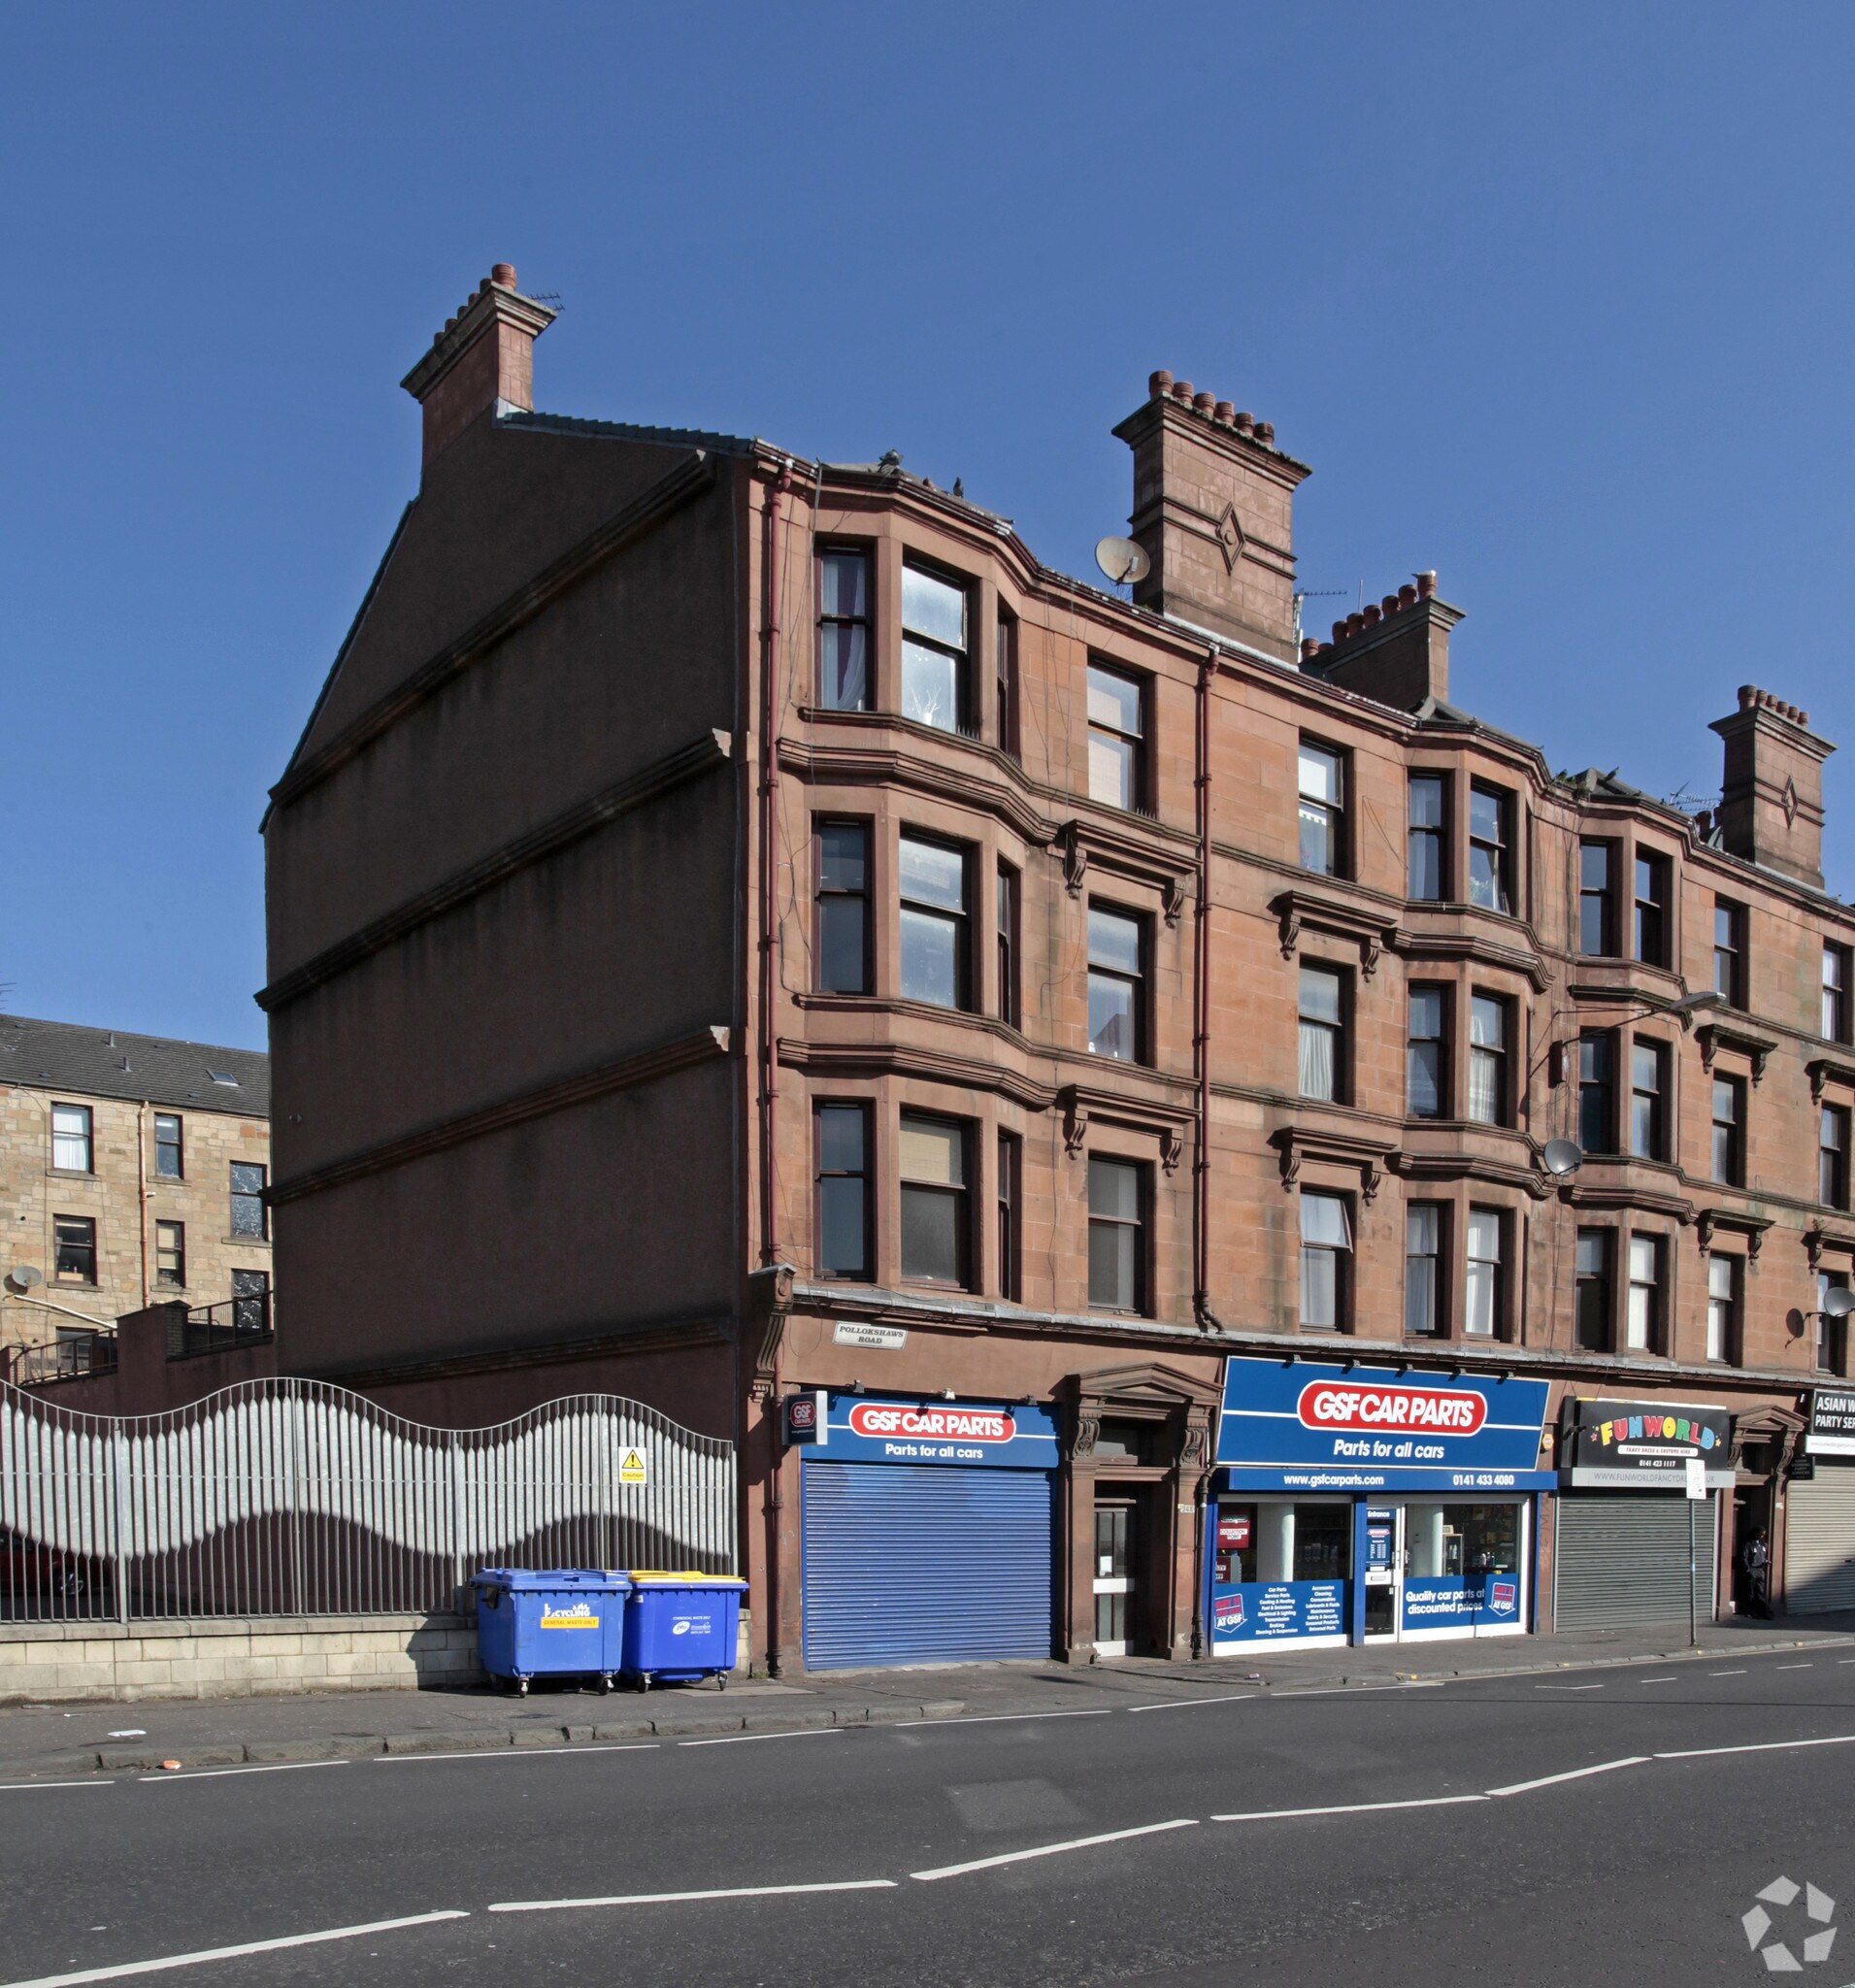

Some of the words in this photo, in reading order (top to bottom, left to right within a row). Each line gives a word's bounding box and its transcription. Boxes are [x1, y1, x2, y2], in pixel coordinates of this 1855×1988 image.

[840, 1326, 904, 1338] POLLOKSHAWS
[858, 1336, 882, 1344] ROAD
[1313, 1390, 1360, 1420] GSF
[1360, 1394, 1408, 1424] CAR
[1408, 1397, 1474, 1427] PARTS
[1816, 1397, 1846, 1411] ASIAN
[794, 1405, 812, 1418] GSF
[862, 1409, 901, 1431] GSF
[902, 1412, 944, 1434] CAR
[946, 1415, 1005, 1437] PARTS
[1815, 1414, 1843, 1428] PARTY
[1600, 1415, 1715, 1450] FUNWORLD
[885, 1443, 917, 1456] Parts
[920, 1445, 937, 1457] for
[939, 1445, 954, 1458] all
[956, 1448, 983, 1459] cars
[1334, 1439, 1371, 1457] Parts
[1373, 1440, 1393, 1457] for
[1394, 1441, 1413, 1458] all
[1414, 1445, 1444, 1459] cars
[1284, 1474, 1384, 1487] www.gsfcarparts.com
[1453, 1474, 1474, 1486] 0141
[1476, 1474, 1493, 1486] 433
[1494, 1474, 1514, 1486] 4080
[1406, 1590, 1438, 1603] Quality
[1438, 1591, 1452, 1601] car
[1453, 1589, 1474, 1602] parts
[1475, 1588, 1485, 1598] at
[1408, 1602, 1456, 1614] discounted
[1457, 1602, 1483, 1613] prices
[1501, 1602, 1512, 1610] GSF
[1217, 1616, 1227, 1628] AT
[1227, 1613, 1242, 1626] GSF
